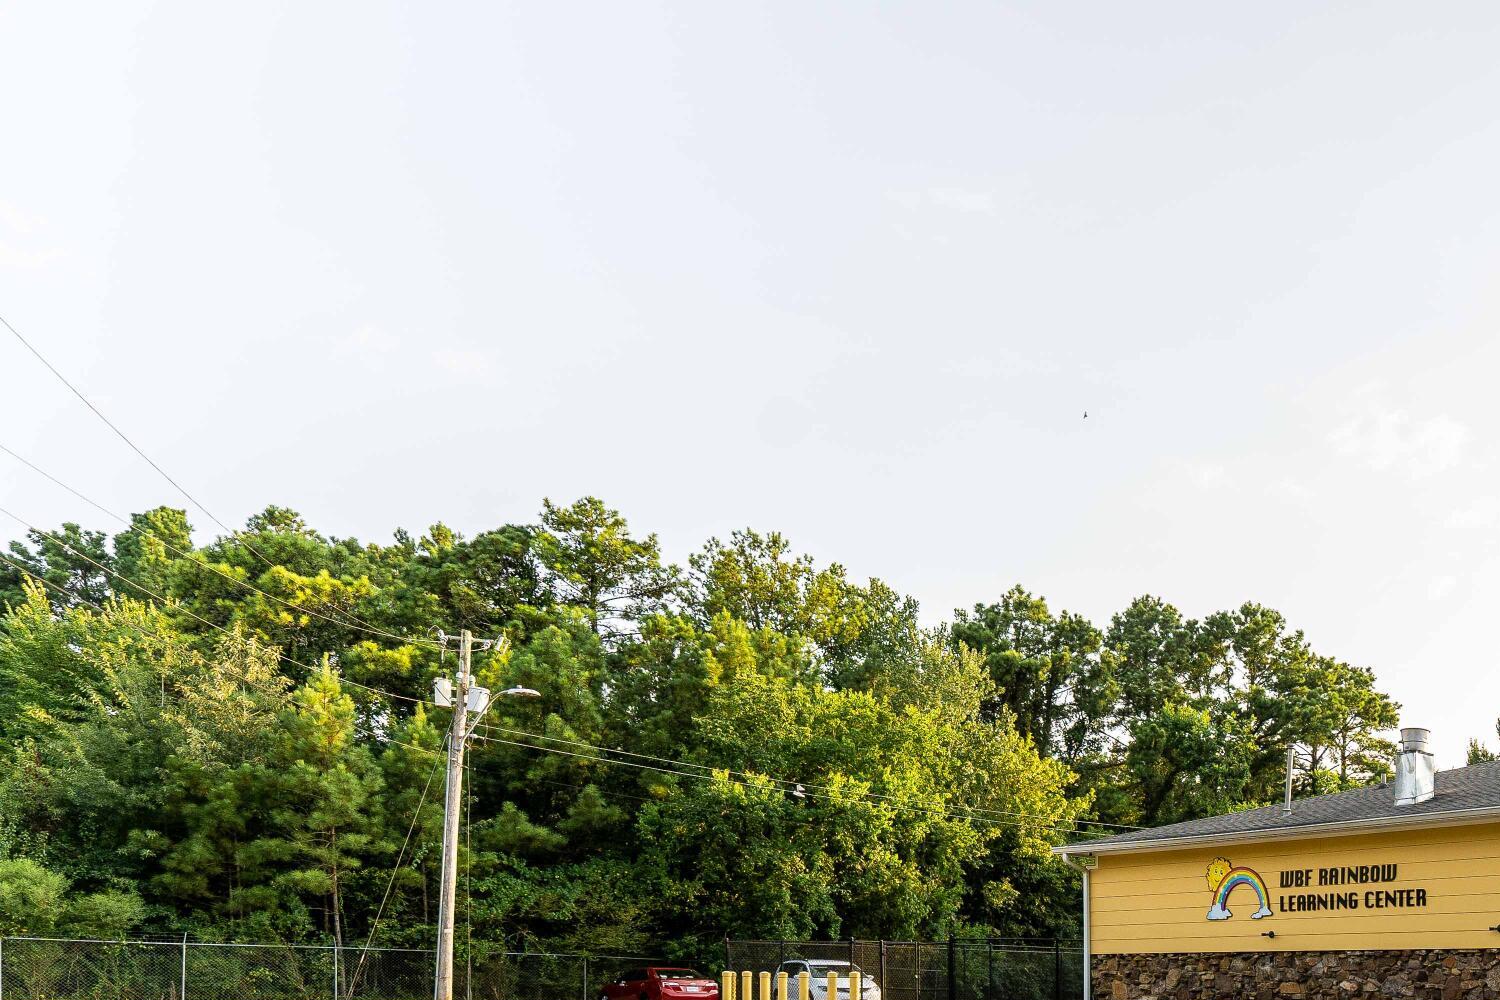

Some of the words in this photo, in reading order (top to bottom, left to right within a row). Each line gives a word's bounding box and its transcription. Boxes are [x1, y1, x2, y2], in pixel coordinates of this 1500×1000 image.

[1279, 869, 1313, 888] WBF
[1318, 864, 1397, 886] RAINBOW
[1279, 892, 1358, 912] LEARNING
[1364, 888, 1427, 909] CENTER
